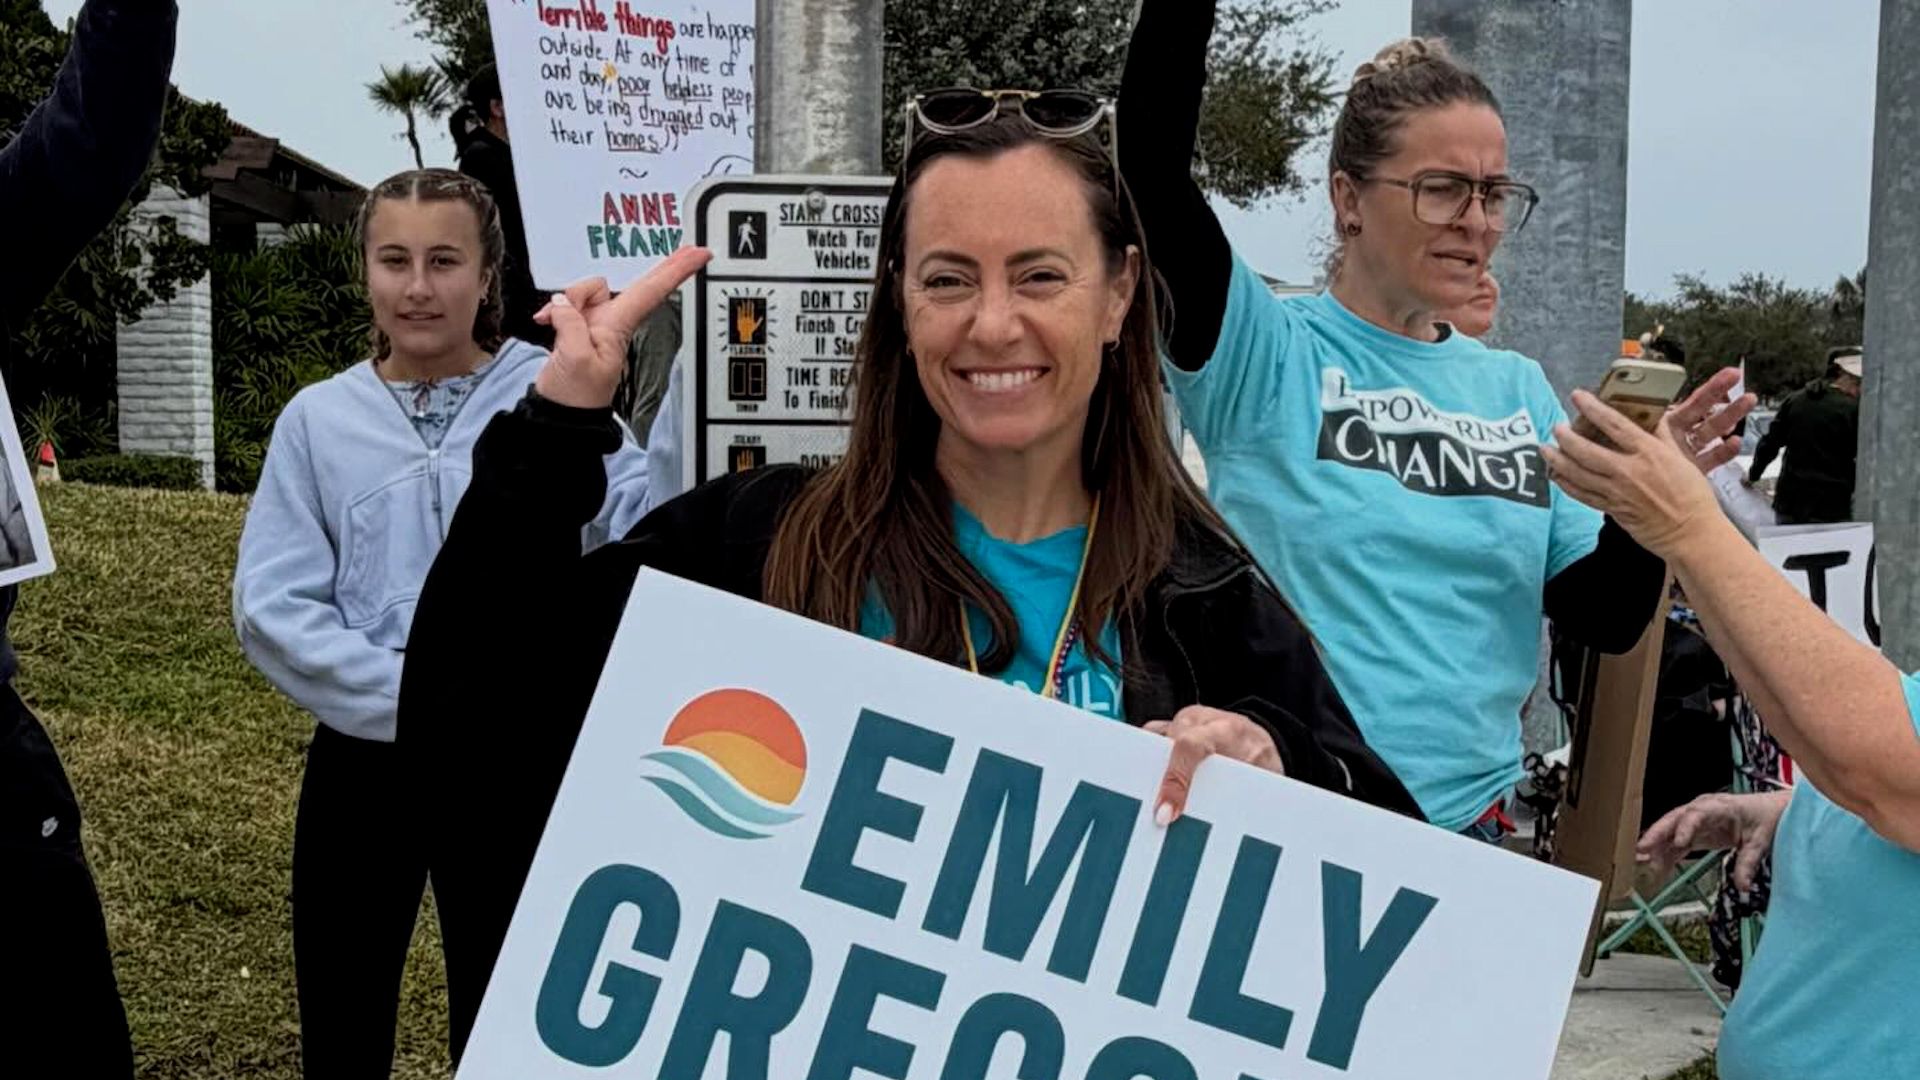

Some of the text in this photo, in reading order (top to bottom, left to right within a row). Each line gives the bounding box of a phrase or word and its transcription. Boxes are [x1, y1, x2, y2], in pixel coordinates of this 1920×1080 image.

[614, 1, 676, 54] things
[679, 22, 704, 38] are
[614, 38, 632, 63] At
[640, 51, 671, 82] any
[676, 45, 710, 74] time
[720, 49, 739, 77] of
[541, 57, 571, 80] and
[618, 75, 651, 103] poor
[662, 74, 713, 106] helpless
[545, 88, 577, 111] are
[583, 85, 632, 126] being
[639, 95, 704, 136] dragged
[709, 108, 738, 136] out
[551, 117, 594, 145] their
[603, 191, 681, 226] ANNE
[807, 229, 877, 248] Watch For
[814, 250, 870, 270] Vehicles
[801, 289, 844, 309] DON'T
[796, 315, 835, 334] Finish
[786, 367, 821, 387] TIME
[784, 389, 799, 409] To
[801, 707, 1438, 1070] EMILY
